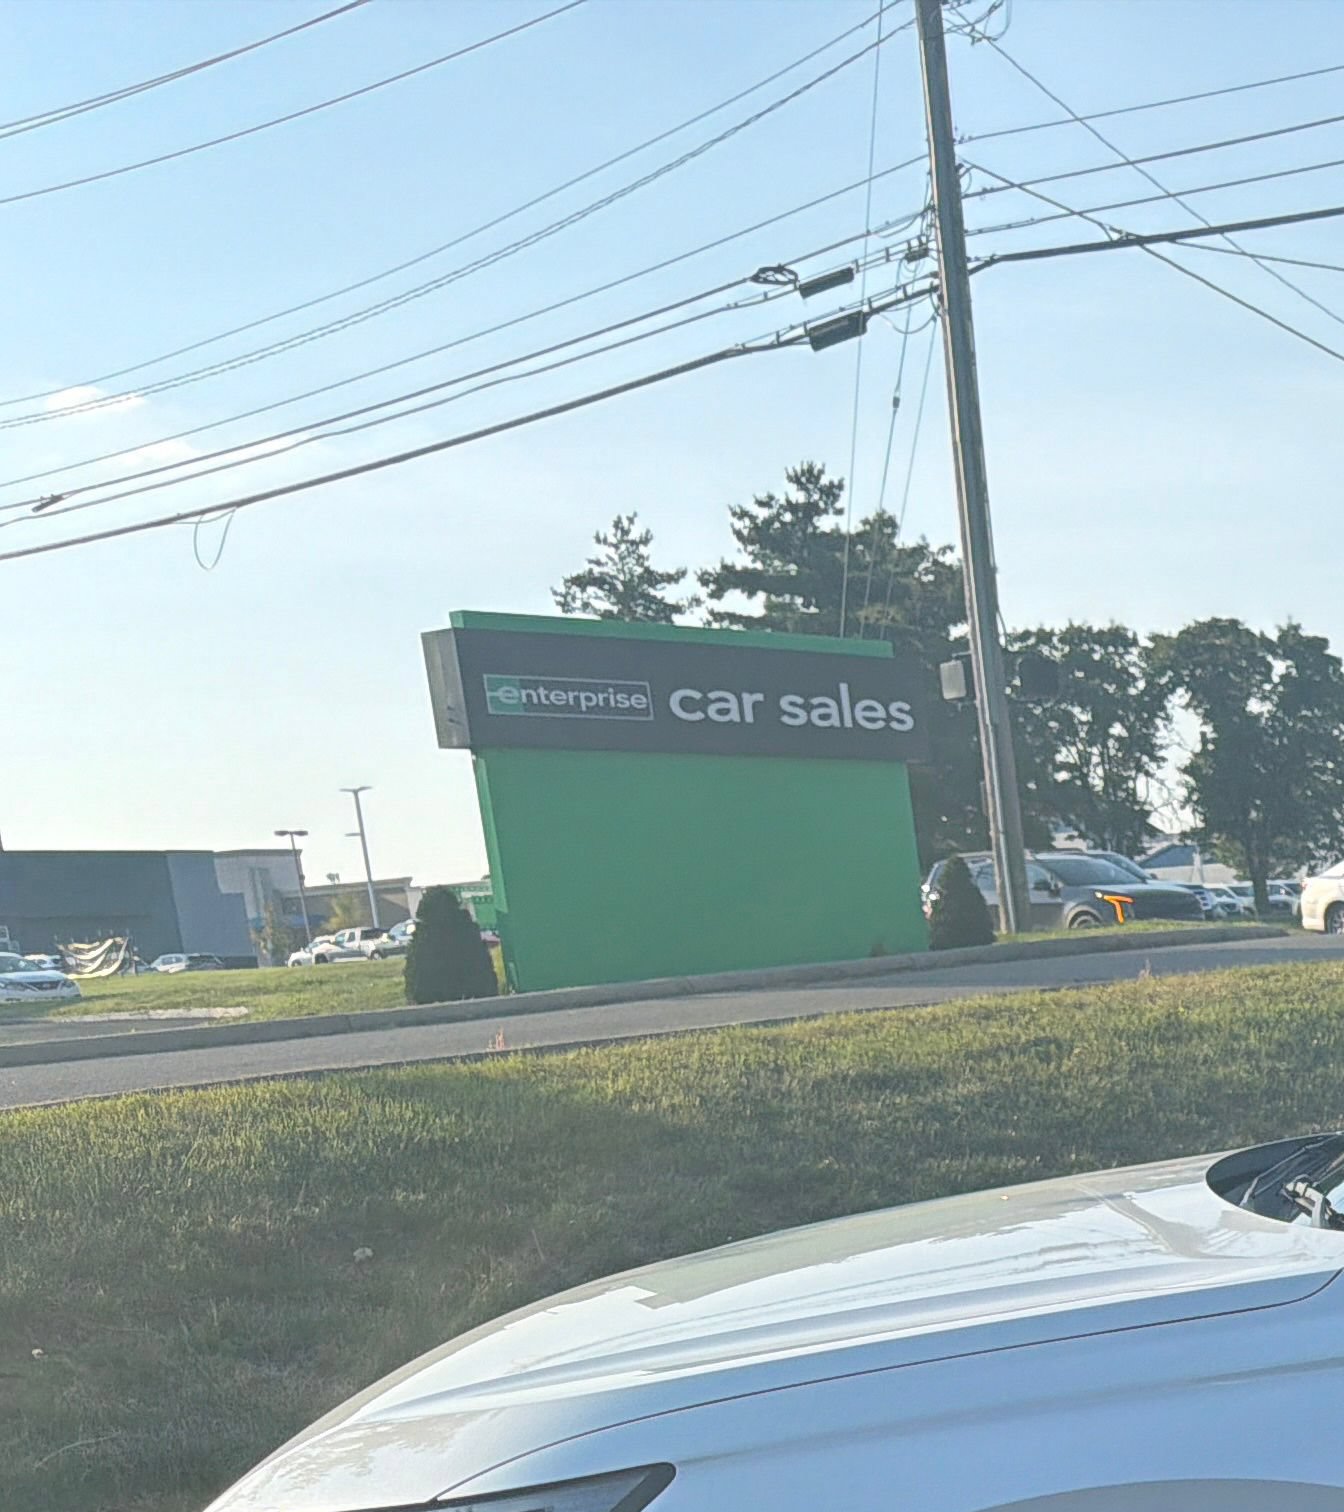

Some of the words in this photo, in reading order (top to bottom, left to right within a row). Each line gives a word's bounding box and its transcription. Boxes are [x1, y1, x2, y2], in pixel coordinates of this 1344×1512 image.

[499, 686, 648, 712] enterprise
[669, 688, 764, 723] car
[779, 682, 914, 731] sales
